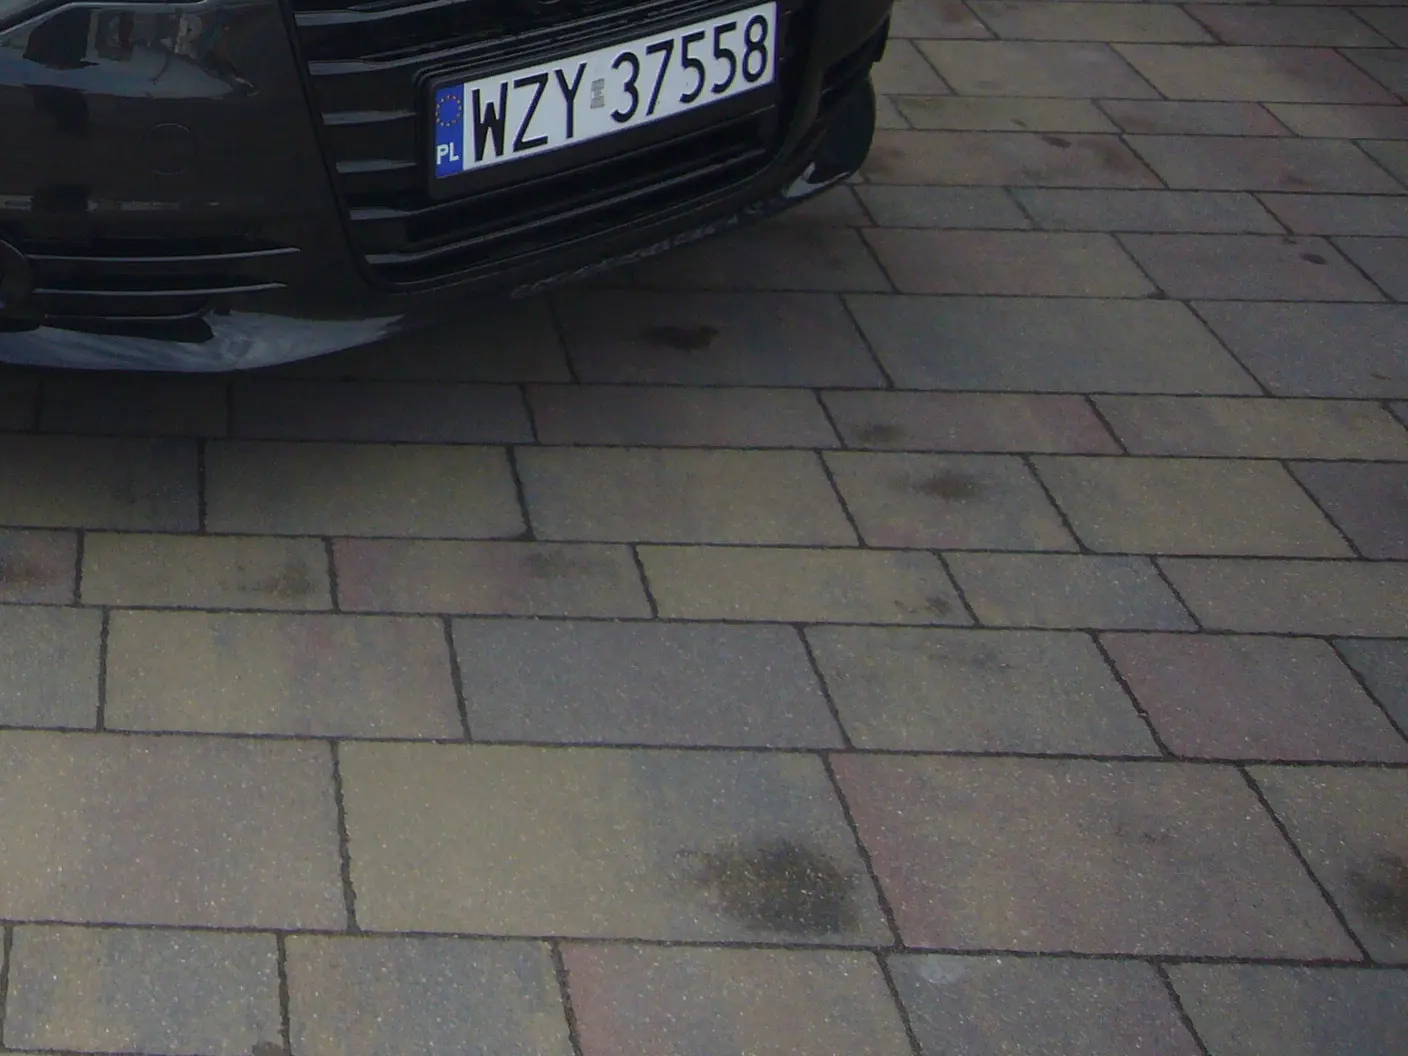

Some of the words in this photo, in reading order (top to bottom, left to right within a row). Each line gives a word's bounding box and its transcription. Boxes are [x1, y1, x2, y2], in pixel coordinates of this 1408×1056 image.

[471, 61, 587, 163] WZY
[610, 13, 770, 124] 37558
[435, 141, 460, 165] PL
